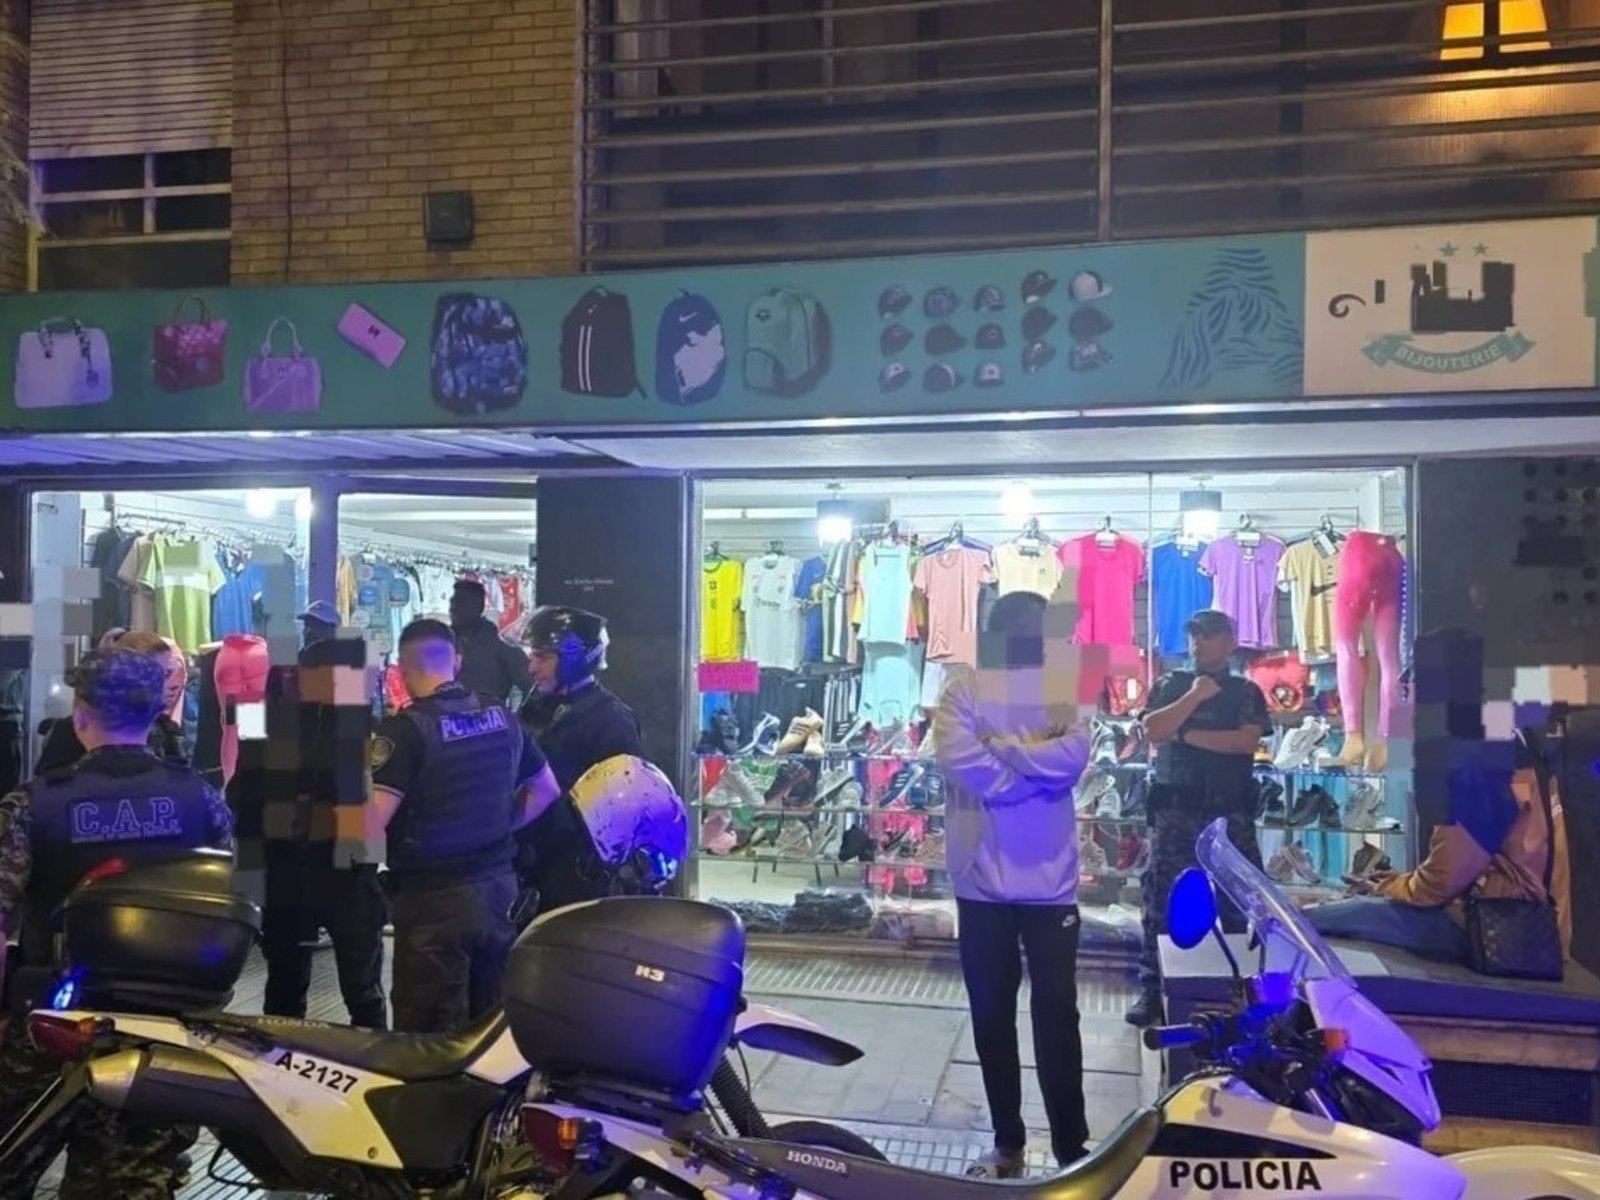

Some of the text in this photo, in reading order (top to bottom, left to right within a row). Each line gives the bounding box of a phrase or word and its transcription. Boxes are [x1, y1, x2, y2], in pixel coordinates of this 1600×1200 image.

[1395, 344, 1502, 370] BIJOUTERIE
[440, 709, 505, 739] POLICIA
[74, 796, 179, 835] C.A.P.
[256, 1017, 330, 1029] HONDA
[275, 1051, 359, 1094] A-2127
[786, 1150, 848, 1174] HONDA
[1169, 1160, 1322, 1191] POLICIA
